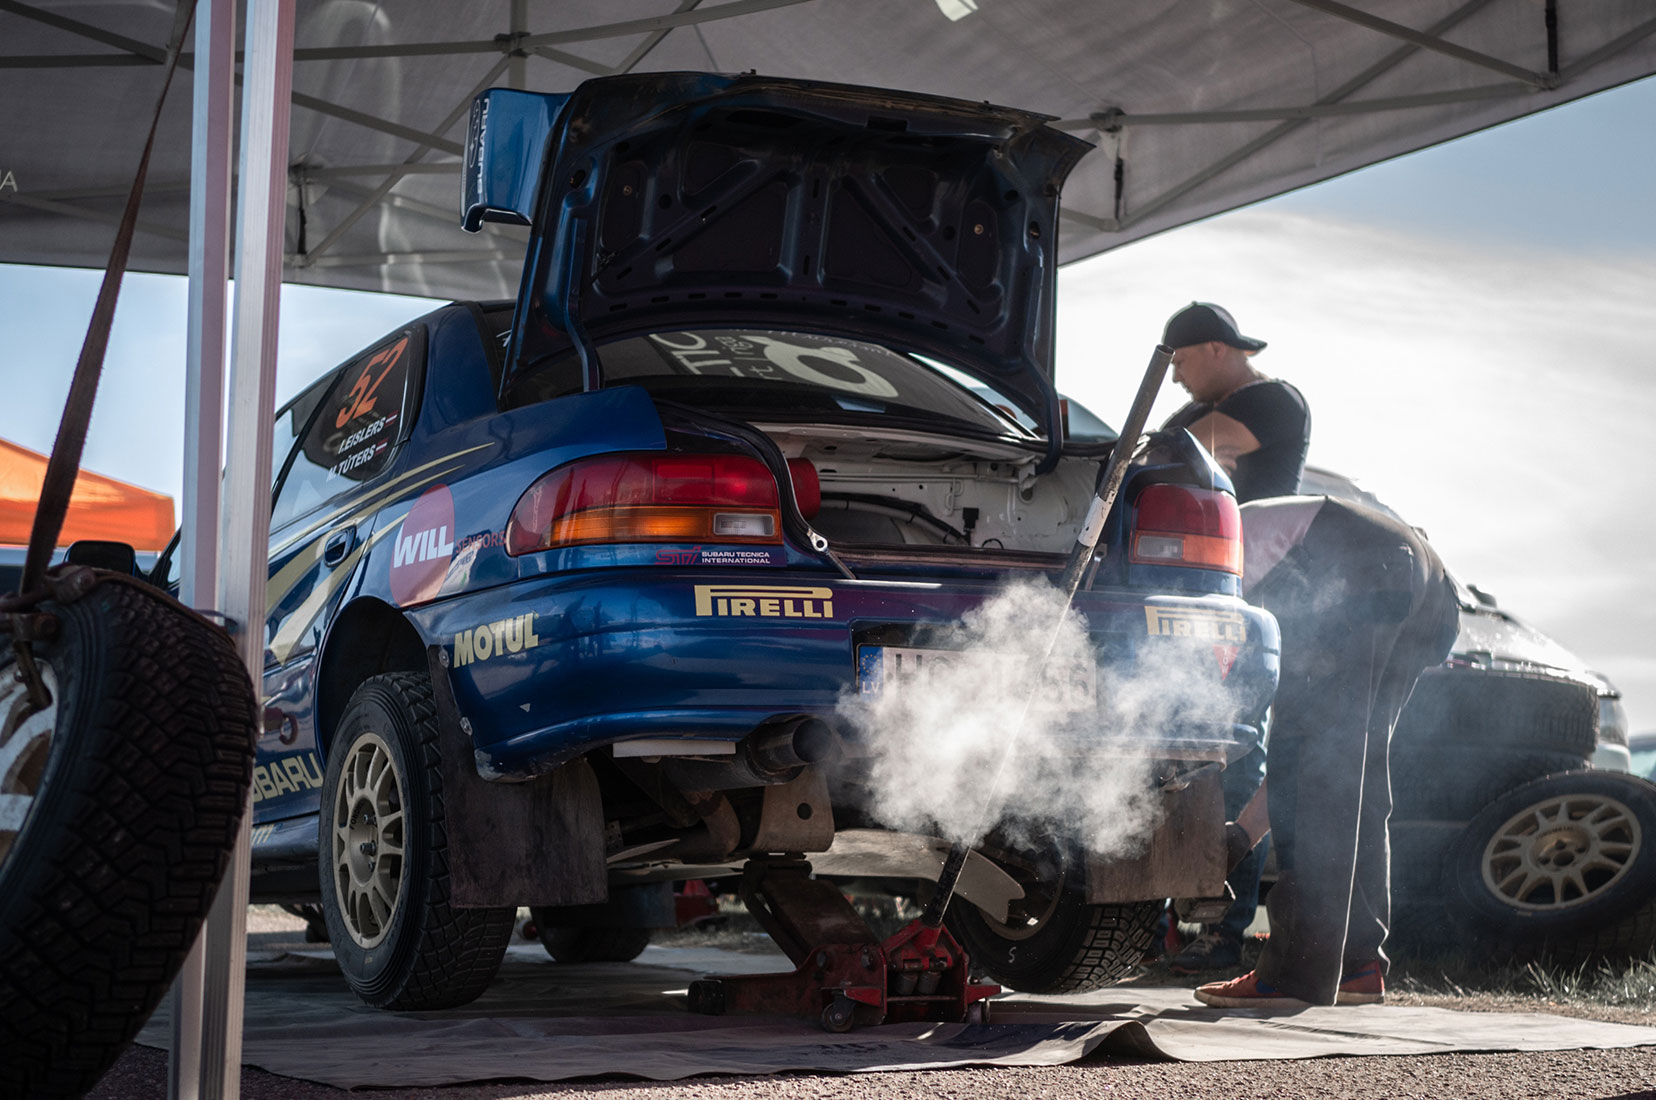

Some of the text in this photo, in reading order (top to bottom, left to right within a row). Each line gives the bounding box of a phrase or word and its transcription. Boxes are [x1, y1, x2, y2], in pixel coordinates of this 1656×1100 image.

[477, 98, 490, 194] SUBARU
[335, 337, 409, 429] 52
[393, 523, 455, 569] WILL
[455, 531, 507, 554] SENSORS
[693, 584, 834, 618] PIRELLI
[453, 612, 539, 669] MOTUL
[1144, 605, 1247, 642] PIRELLI
[862, 682, 881, 694] LV
